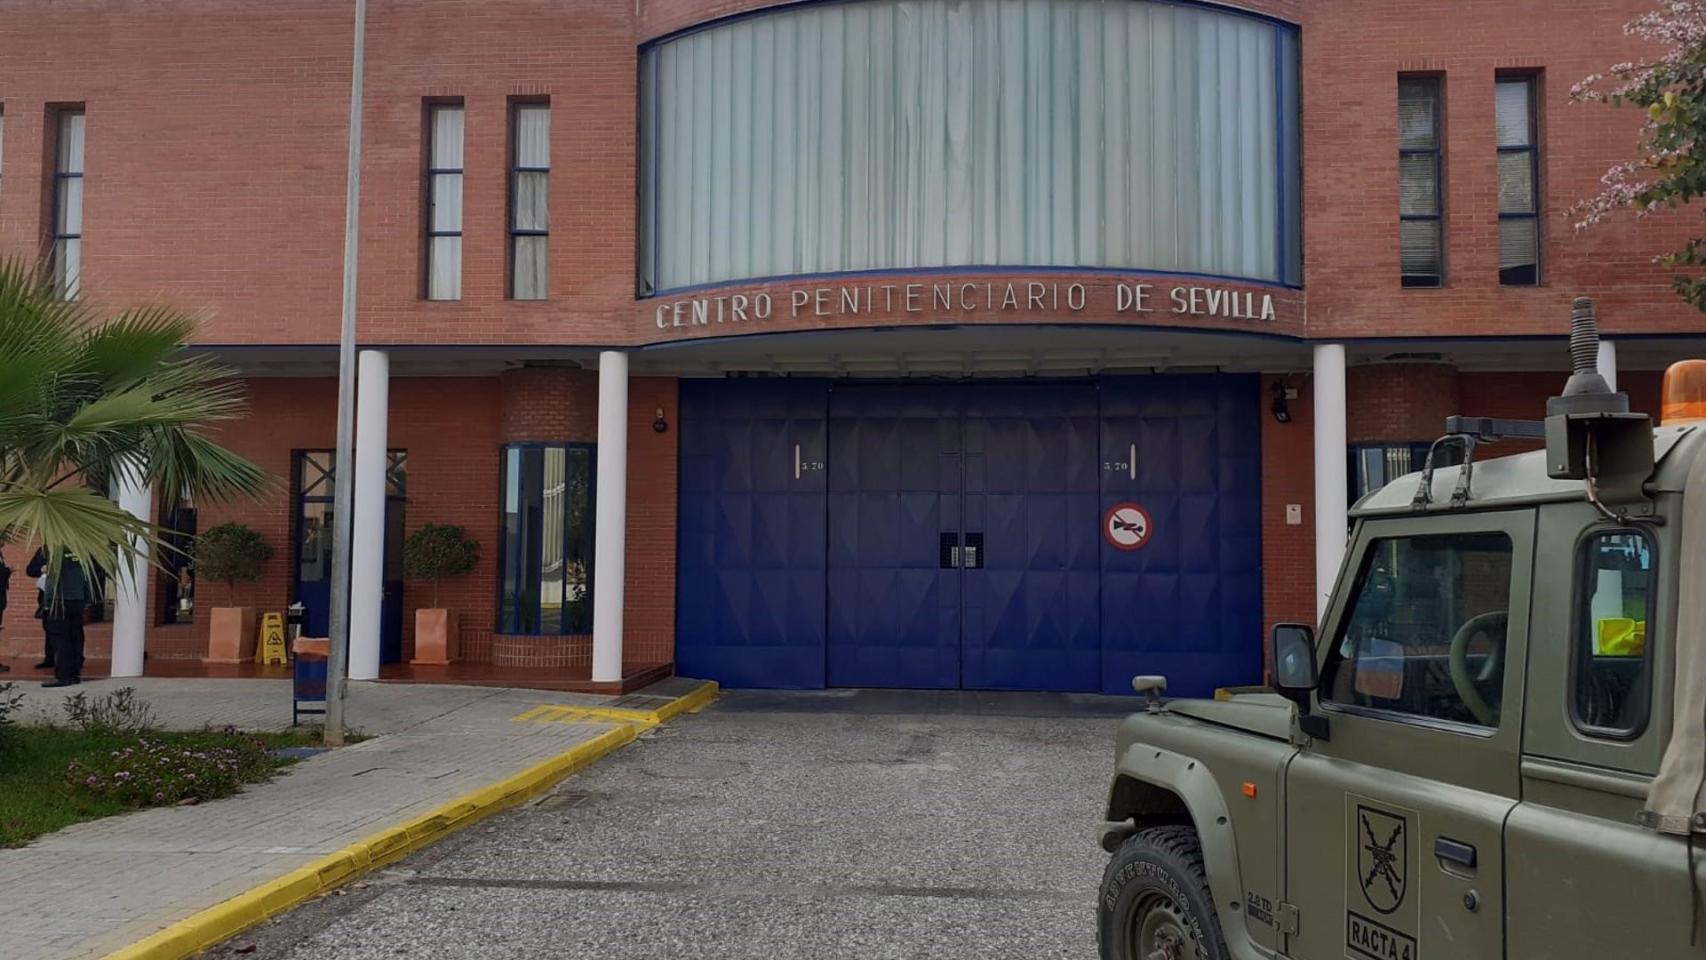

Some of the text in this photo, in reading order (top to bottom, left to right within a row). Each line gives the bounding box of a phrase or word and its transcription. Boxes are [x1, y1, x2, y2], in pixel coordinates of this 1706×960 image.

[656, 282, 1276, 329] CENTRO PENITENCIARIO DE SEVILLA
[1261, 897, 1273, 912] TD
[1352, 920, 1410, 960] RACTA 4
